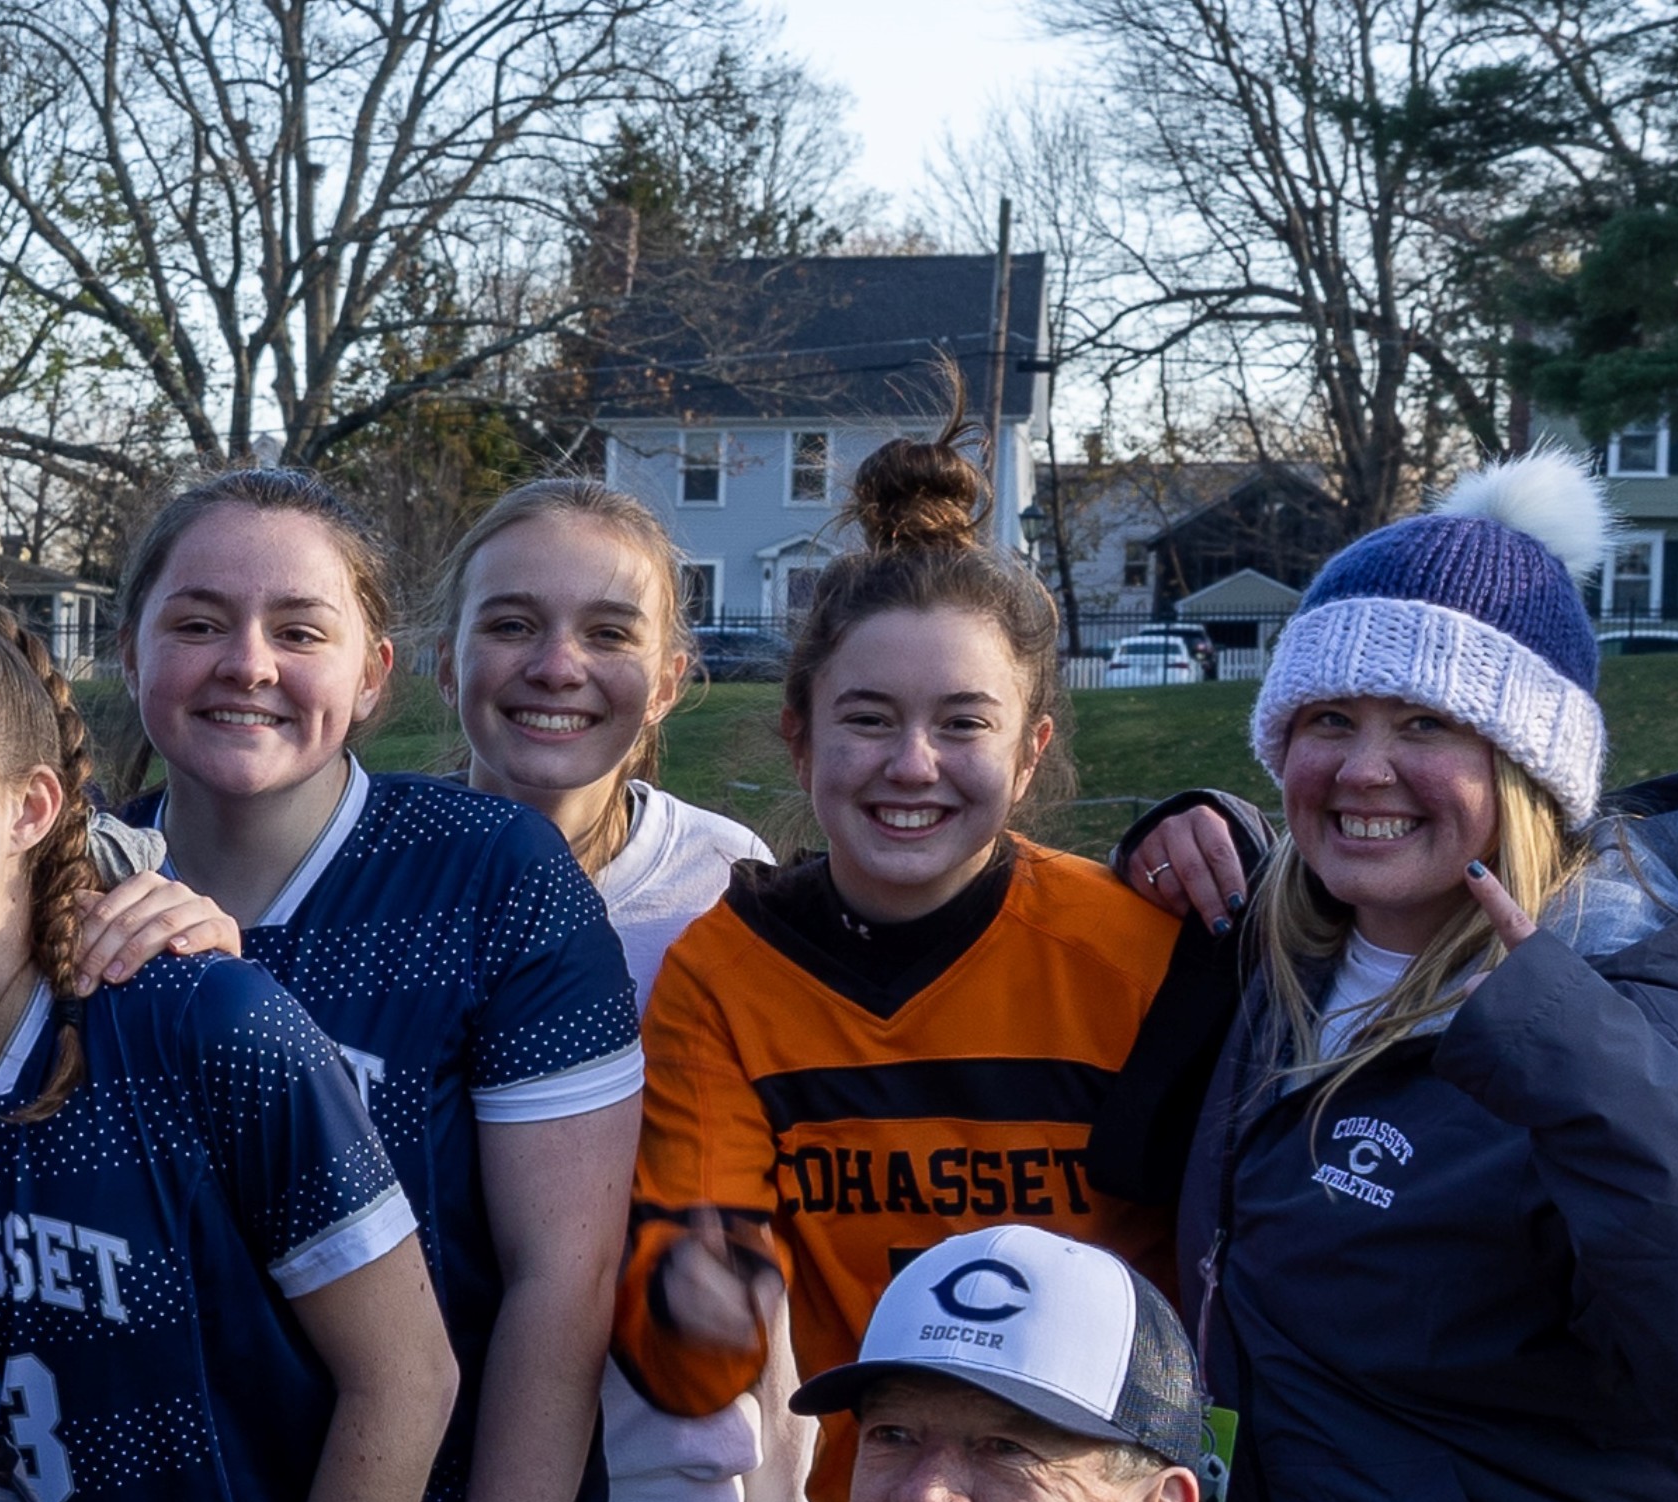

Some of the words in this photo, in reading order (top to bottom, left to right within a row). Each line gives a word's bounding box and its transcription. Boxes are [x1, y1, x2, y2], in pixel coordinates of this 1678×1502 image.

[1332, 1117, 1414, 1166] COHASSET
[1311, 1164, 1395, 1209] ATHLETICS
[919, 1325, 1004, 1350] SOCCER
